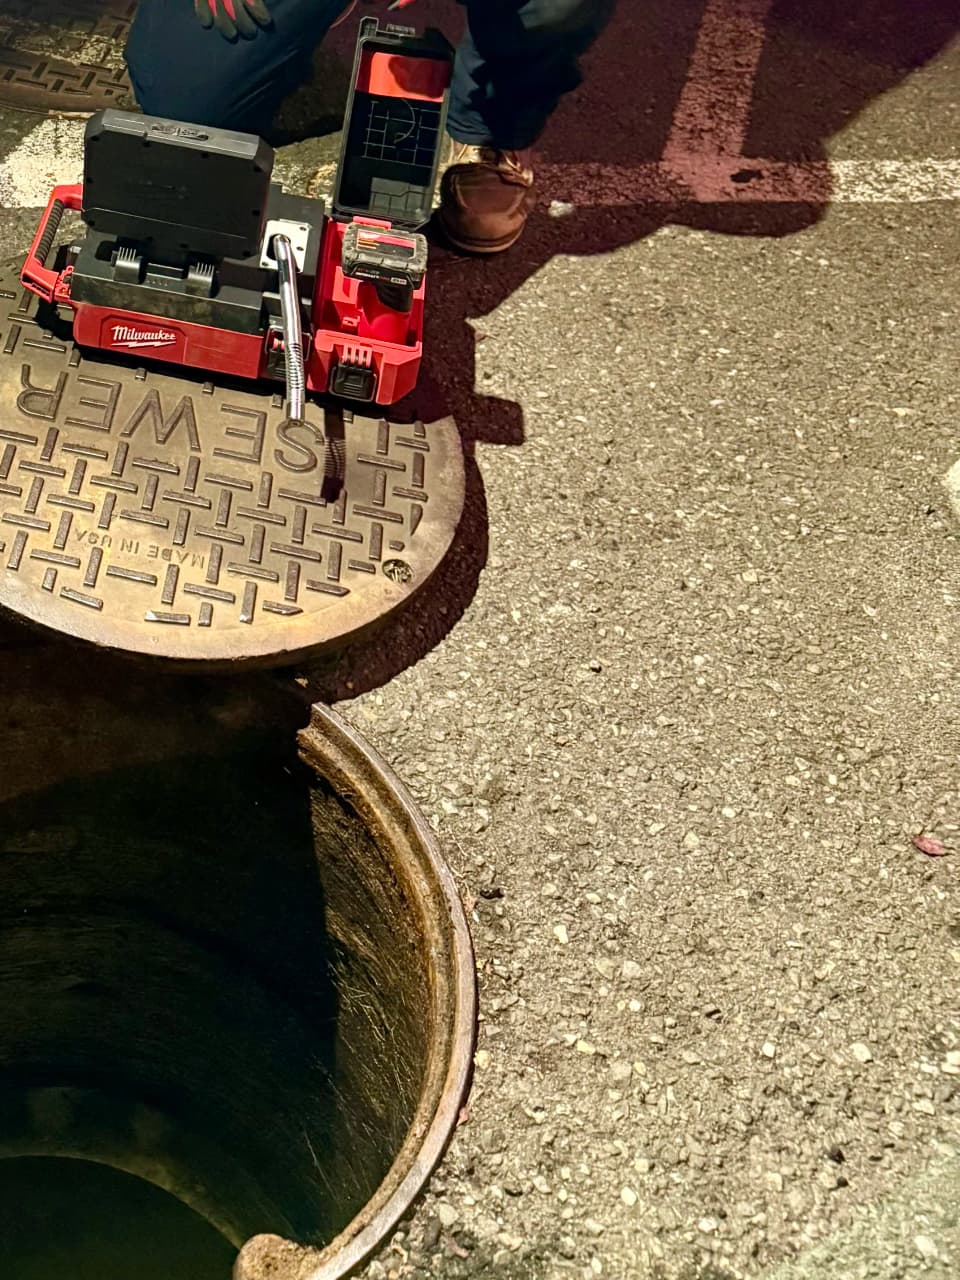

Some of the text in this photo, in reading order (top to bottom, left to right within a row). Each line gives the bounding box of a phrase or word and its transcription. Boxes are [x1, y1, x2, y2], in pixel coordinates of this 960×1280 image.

[110, 325, 177, 341] Milwaukee
[16, 362, 326, 474] SEWER
[73, 527, 206, 569] MADE IN USA
